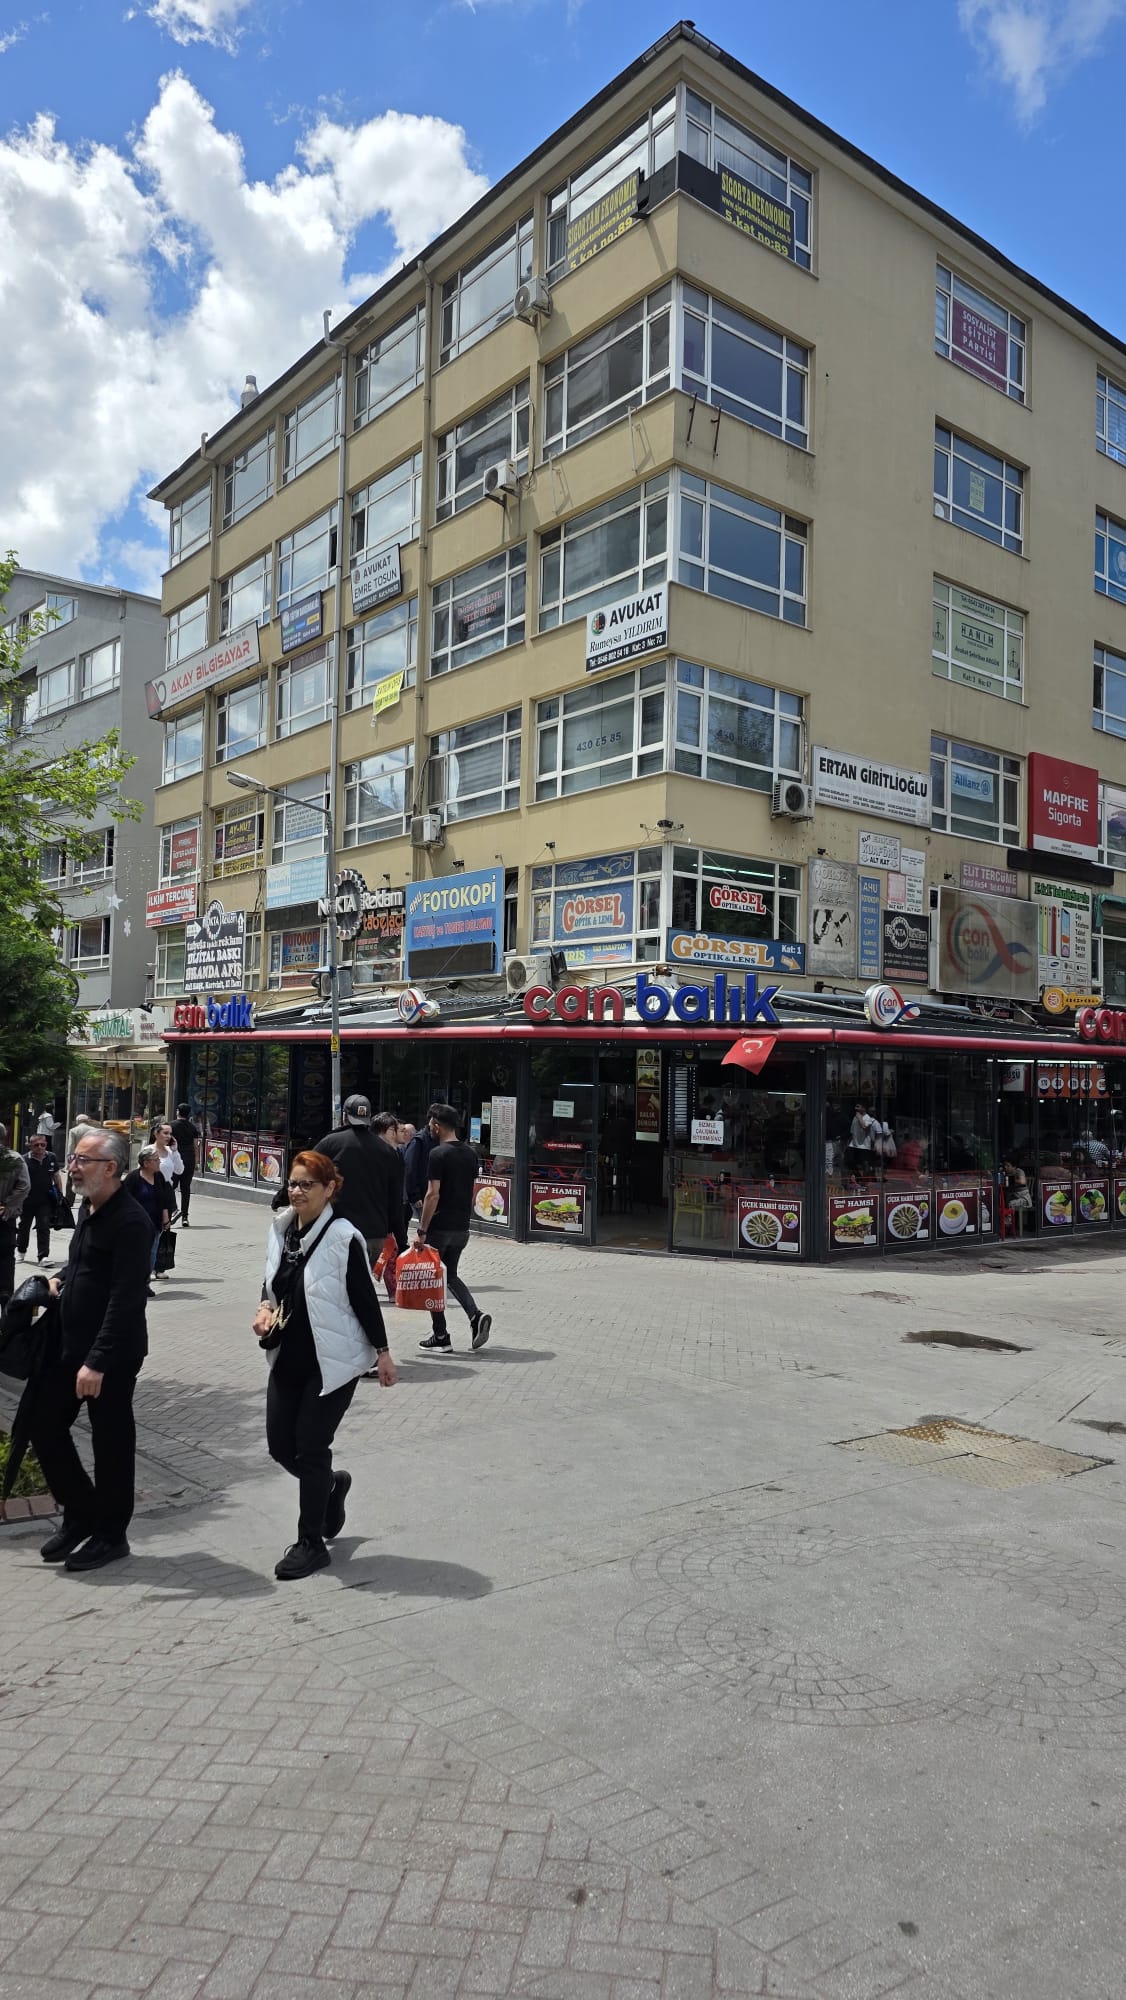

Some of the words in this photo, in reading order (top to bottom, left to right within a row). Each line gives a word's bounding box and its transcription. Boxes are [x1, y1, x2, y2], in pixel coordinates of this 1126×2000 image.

[757, 231, 789, 256] no:89
[963, 336, 996, 363] PARTİSİ
[363, 555, 392, 579] AVUKAT
[354, 581, 372, 599] EMRE
[374, 568, 397, 589] TOSUN
[609, 592, 662, 627] AVUKAT
[624, 616, 663, 640] YILDIRIM
[171, 669, 194, 694] AKAY
[196, 639, 251, 681] BİLGİSAYAR
[576, 739, 593, 753] 430
[819, 756, 856, 780] ERTAN
[860, 764, 928, 798] GİRİTLİOĞLU
[954, 773, 981, 792] Allianz
[1043, 788, 1089, 813] MAPFRE
[1048, 806, 1082, 827] Sigorta
[980, 869, 1017, 885] TERCÜME
[148, 891, 165, 907] İLKİM
[166, 886, 194, 903] TERCÜME
[318, 894, 358, 917] NKTA
[362, 890, 403, 911] Reklam
[422, 874, 496, 913] FOTOKOPİ
[710, 885, 766, 914] GÖRSEL
[563, 895, 624, 932] GÖRSEL
[672, 934, 774, 966] GÖRSEL
[782, 944, 796, 953] Kat:
[797, 946, 802, 954] 1
[962, 928, 990, 948] can
[216, 948, 242, 962] BASKI
[732, 956, 756, 964] LENS
[523, 985, 626, 1022] can
[636, 972, 781, 1023] balık
[882, 998, 898, 1008] can
[174, 1004, 206, 1028] can
[208, 994, 253, 1028] balık
[552, 1188, 582, 1196] HAMSİ
[847, 1198, 874, 1208] HAMSİ
[397, 1280, 420, 1290] ELECEK
[398, 1270, 436, 1281] HEDİYEMİZ
